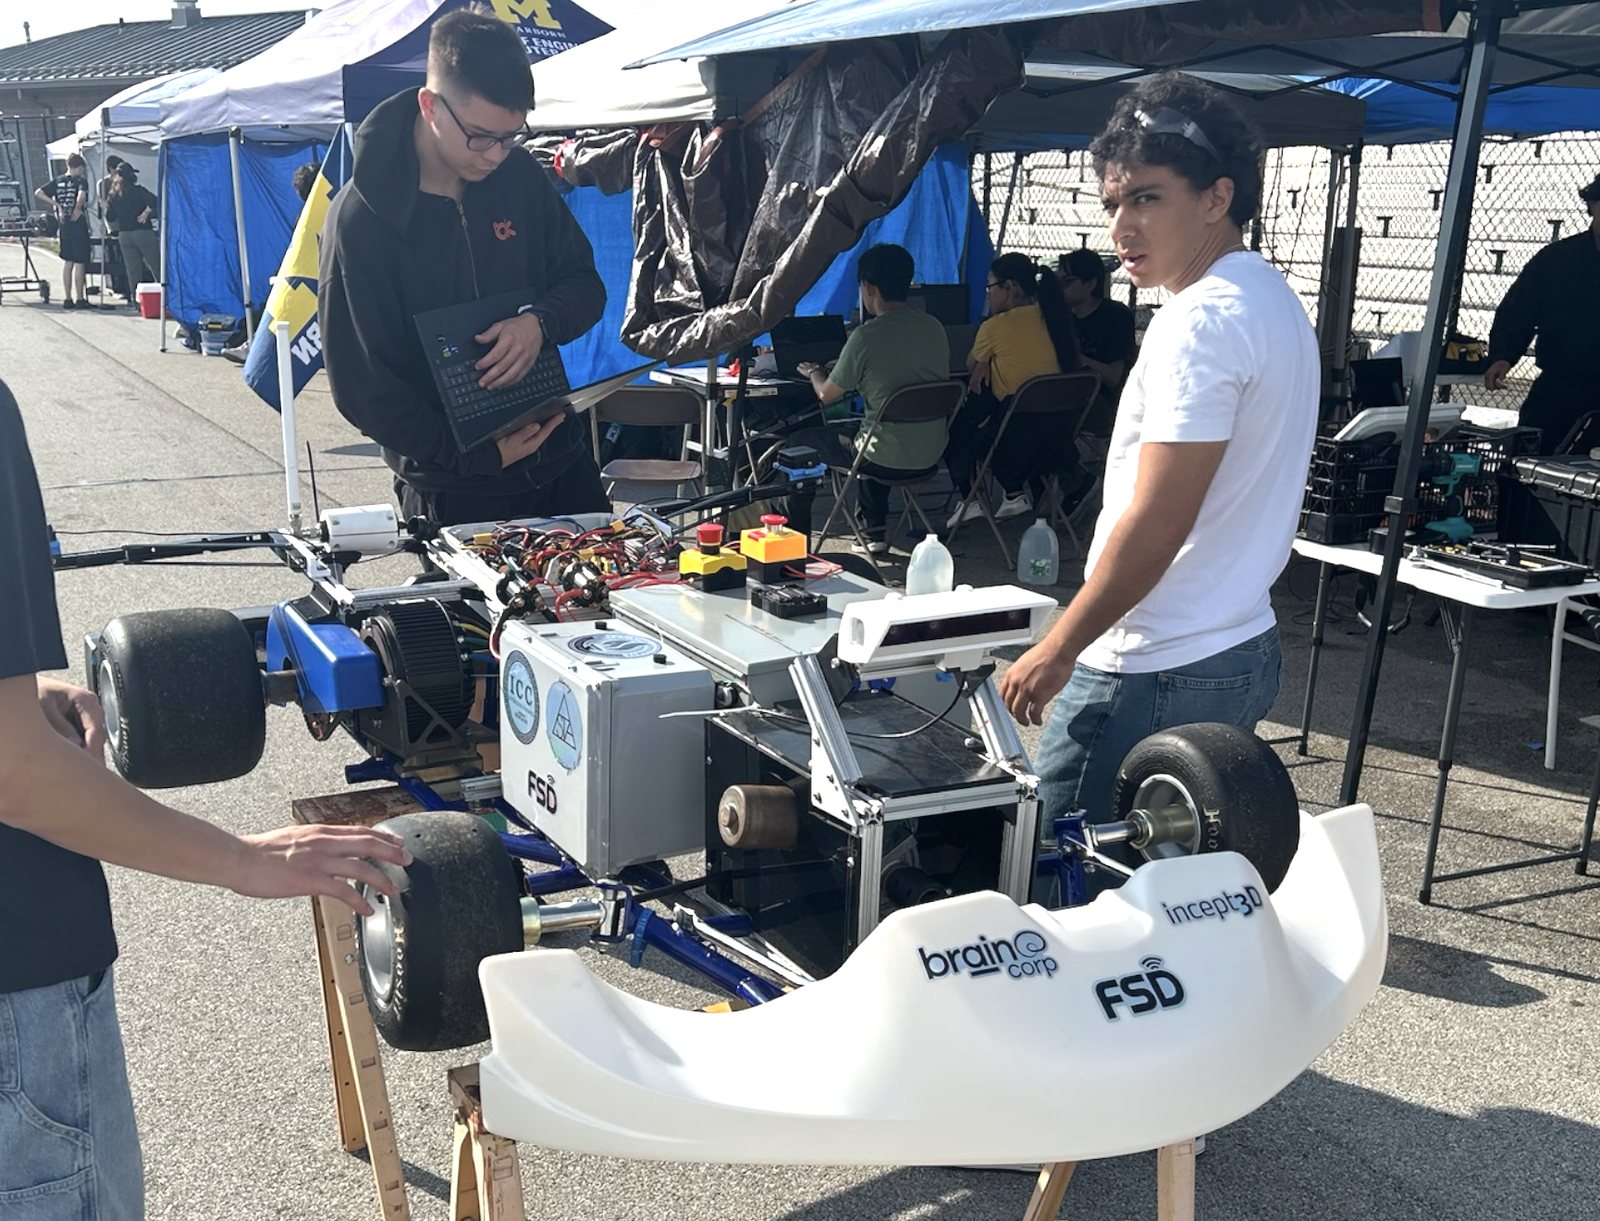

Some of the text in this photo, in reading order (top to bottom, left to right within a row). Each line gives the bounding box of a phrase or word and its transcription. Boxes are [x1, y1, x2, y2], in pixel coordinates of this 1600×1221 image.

[517, 26, 567, 38] ARBORN
[532, 37, 578, 50] ENGIN
[509, 674, 533, 706] ICC
[528, 769, 557, 814] FSD
[1162, 885, 1263, 924] incept3D
[918, 935, 1018, 979] brain
[1008, 957, 1057, 978] corp
[1095, 970, 1185, 1019] FSD
